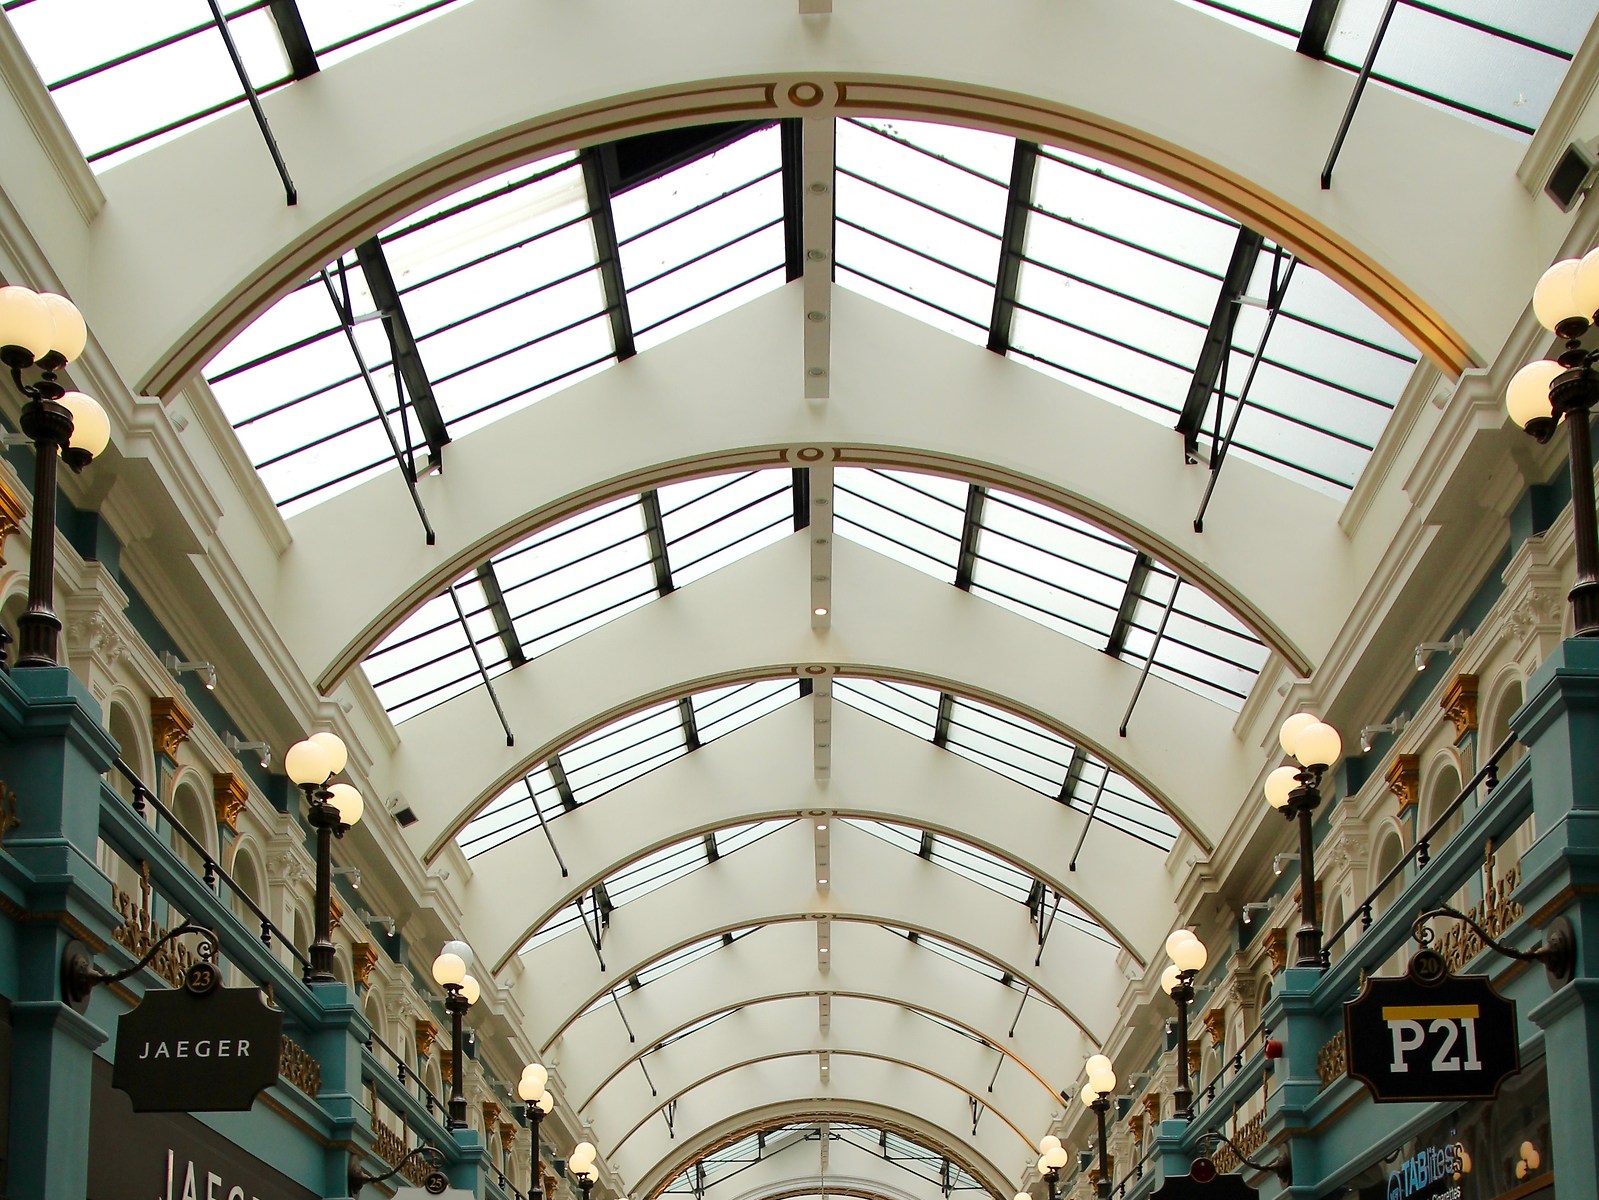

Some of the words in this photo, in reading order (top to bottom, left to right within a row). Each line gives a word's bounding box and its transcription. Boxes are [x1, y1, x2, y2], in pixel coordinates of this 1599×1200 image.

[1419, 958, 1438, 975] 20
[192, 971, 211, 986] 23
[139, 1040, 250, 1059] JAEGER
[1387, 1018, 1482, 1073] P21
[429, 1177, 443, 1188] 25
